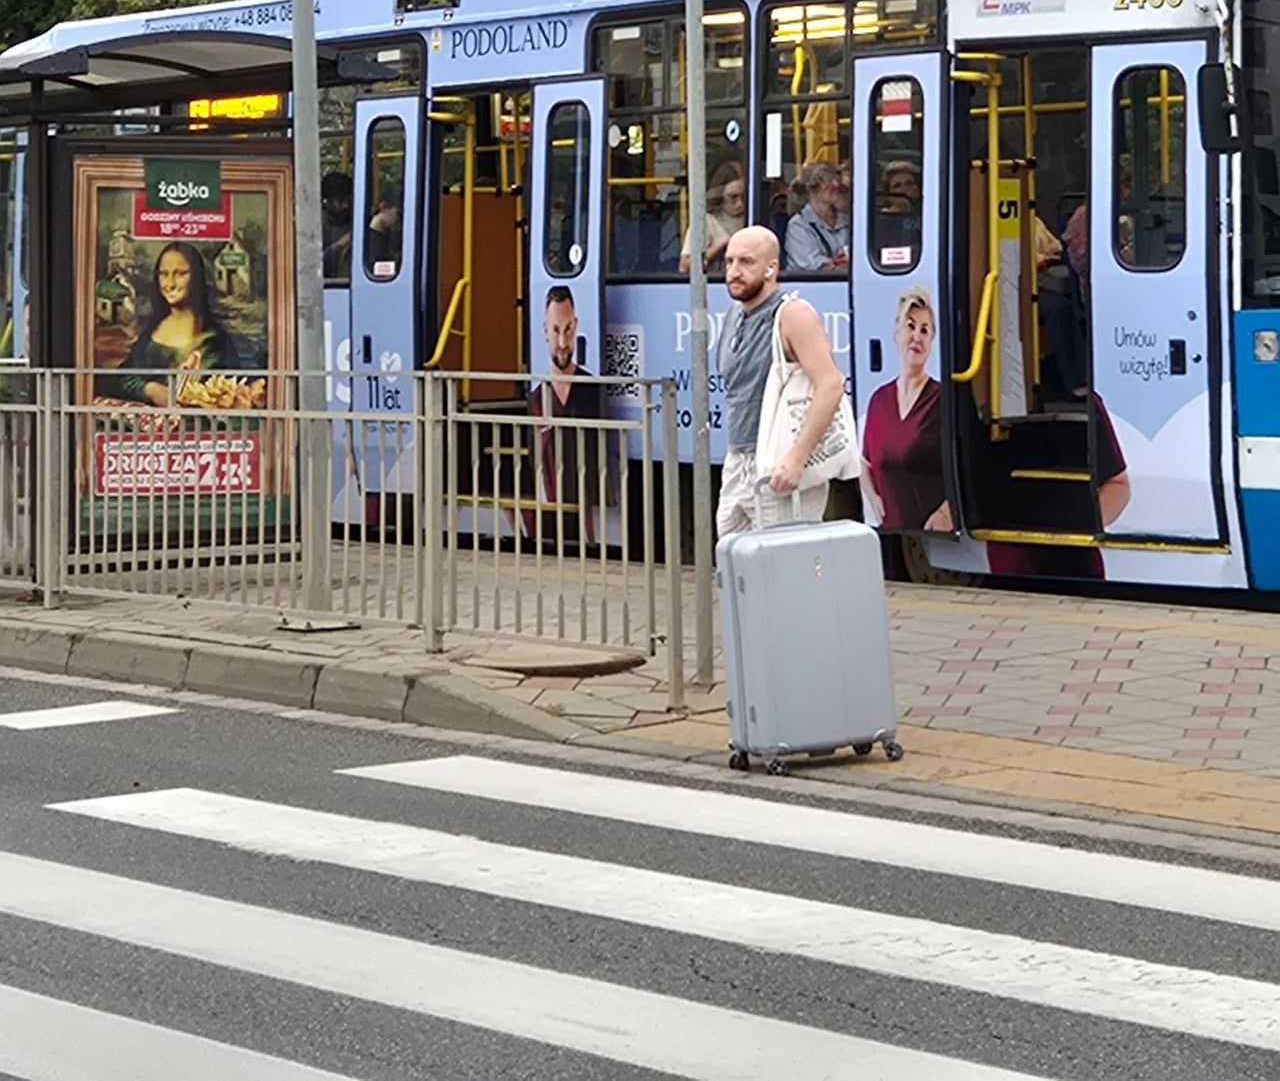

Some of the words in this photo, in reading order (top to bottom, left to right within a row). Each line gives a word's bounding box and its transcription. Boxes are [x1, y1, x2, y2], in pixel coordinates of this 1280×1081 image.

[1000, 1, 1031, 15] MPK
[451, 19, 568, 59] PODOLAND
[158, 180, 209, 199] żabka
[1114, 326, 1157, 348] Umów
[1120, 354, 1169, 381] wizytę!
